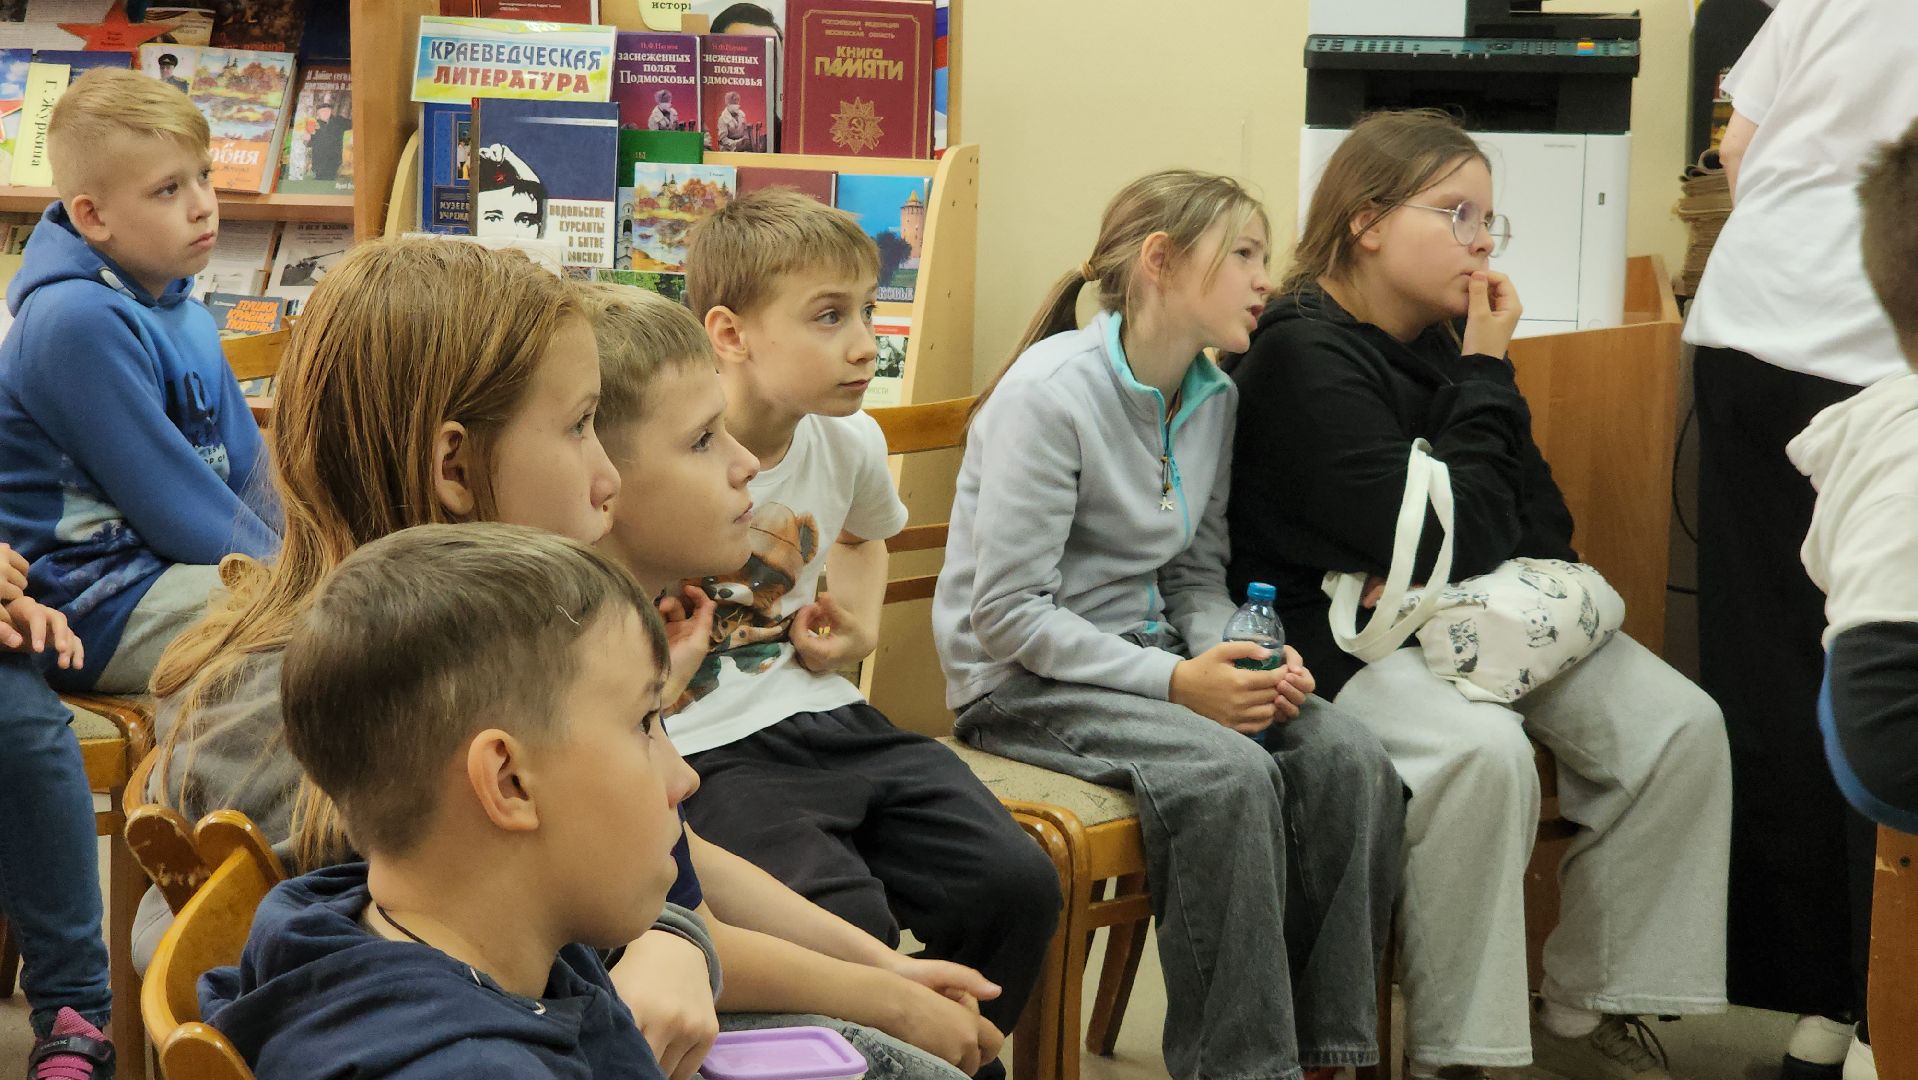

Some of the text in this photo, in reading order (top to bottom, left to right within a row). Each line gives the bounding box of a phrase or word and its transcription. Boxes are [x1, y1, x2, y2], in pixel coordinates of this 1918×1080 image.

[430, 40, 602, 71] КРАЕВЕДЧЕСКАЯ
[617, 52, 691, 63] заснеженных
[643, 64, 677, 73] полях
[714, 65, 745, 75] полях
[815, 56, 904, 80] ПАМЯТИ
[434, 65, 590, 93] ЛИТЕРАТУРА
[620, 70, 695, 84] Подмосковья
[549, 205, 605, 218] ПОДОЛЬСКИЕ
[559, 220, 605, 233] КУРСАНТЫ
[578, 236, 605, 248] БИТВЕ
[567, 251, 604, 264] МОСКВУ
